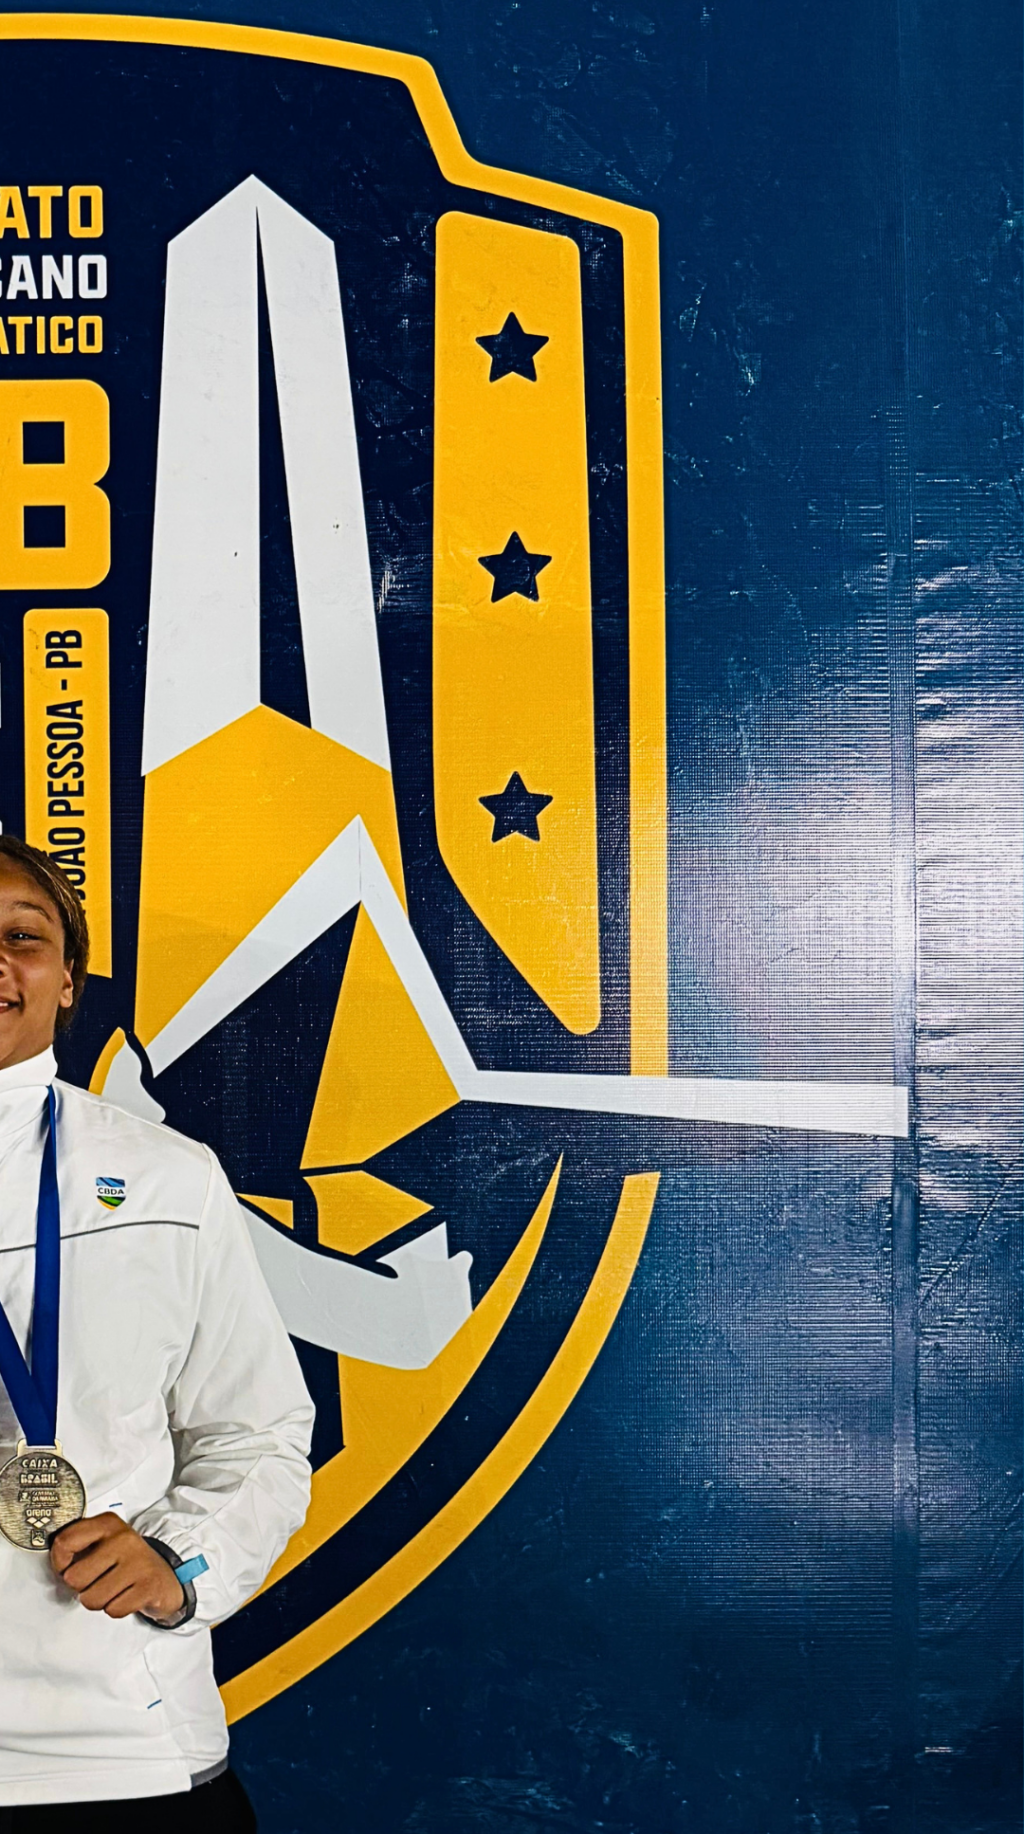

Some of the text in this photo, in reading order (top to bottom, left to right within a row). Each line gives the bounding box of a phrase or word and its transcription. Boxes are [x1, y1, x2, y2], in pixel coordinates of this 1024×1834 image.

[46, 629, 84, 669] PB
[46, 699, 85, 817] PESSOA
[97, 1187, 125, 1195] CBDA
[22, 1459, 58, 1468] CAIXA
[20, 1473, 58, 1484] BRASIL
[26, 1509, 52, 1517] arena
